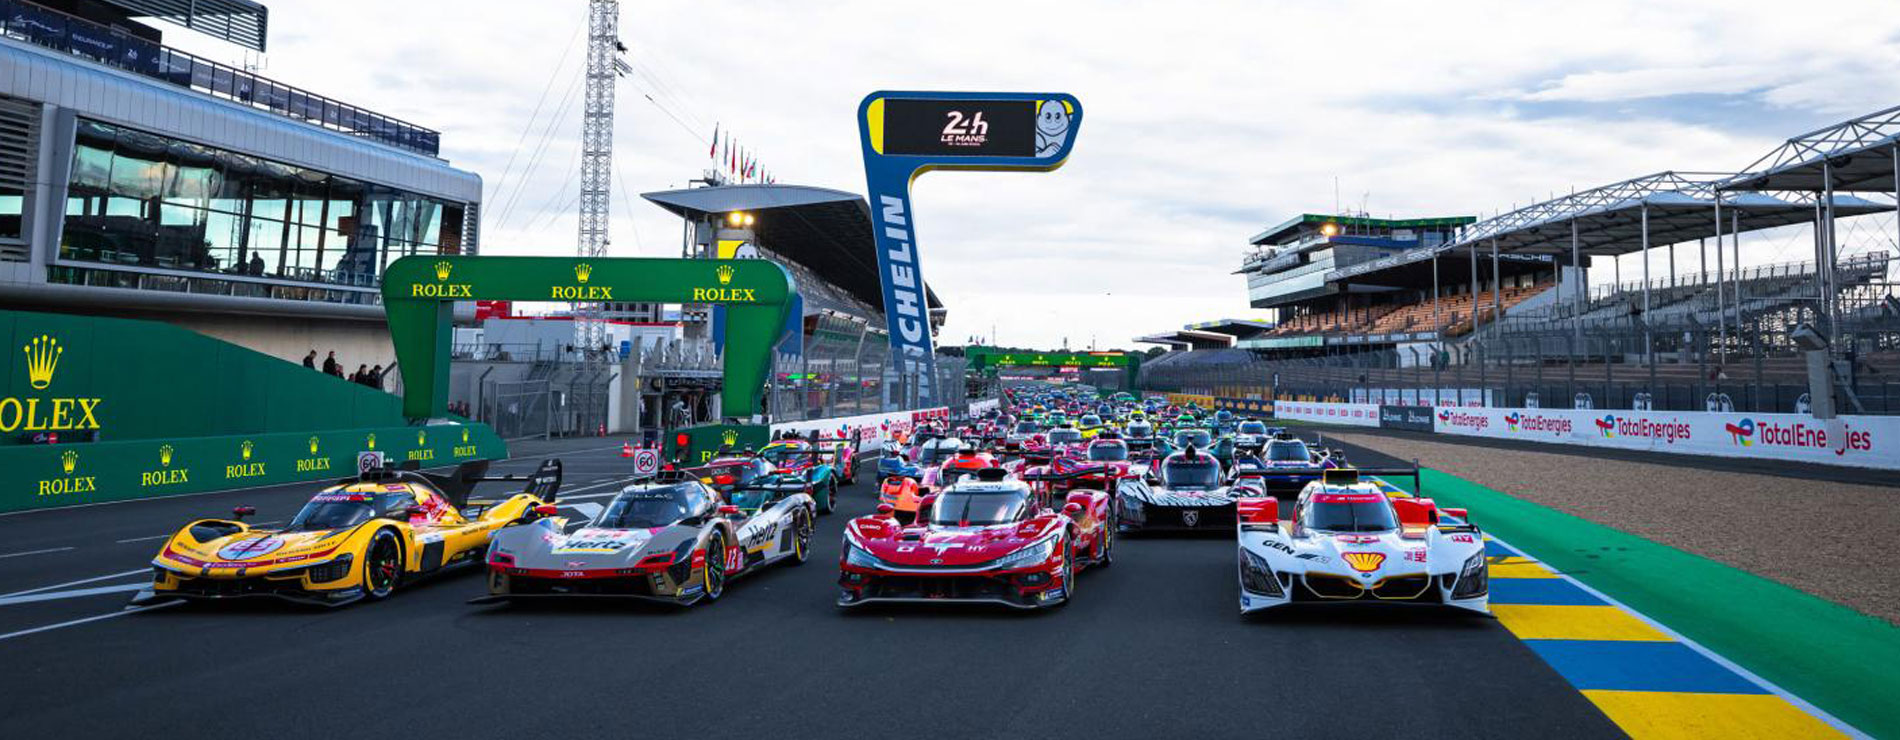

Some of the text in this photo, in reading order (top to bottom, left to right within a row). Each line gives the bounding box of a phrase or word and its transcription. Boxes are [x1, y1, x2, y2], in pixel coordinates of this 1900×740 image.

[942, 110, 988, 134] 24h
[412, 284, 472, 298] ROLEX
[551, 286, 613, 300] ROLEX
[693, 288, 755, 301] ROLEX
[0, 397, 101, 432] OLEX
[1520, 415, 1572, 436] TotalEnergies
[1618, 418, 1690, 443] TotalEnergies
[1757, 422, 1871, 455] TotalEneies
[408, 449, 434, 461] ROLEX
[454, 445, 477, 458] ROLEX
[297, 457, 331, 471] ROLEX
[362, 458, 377, 468] 60
[640, 456, 653, 465] 60
[142, 469, 189, 486] ROLEX
[226, 462, 266, 478] ROLEX
[39, 477, 96, 495] ROLEX
[559, 540, 627, 550] Hertz
[1262, 539, 1295, 555] GEN
